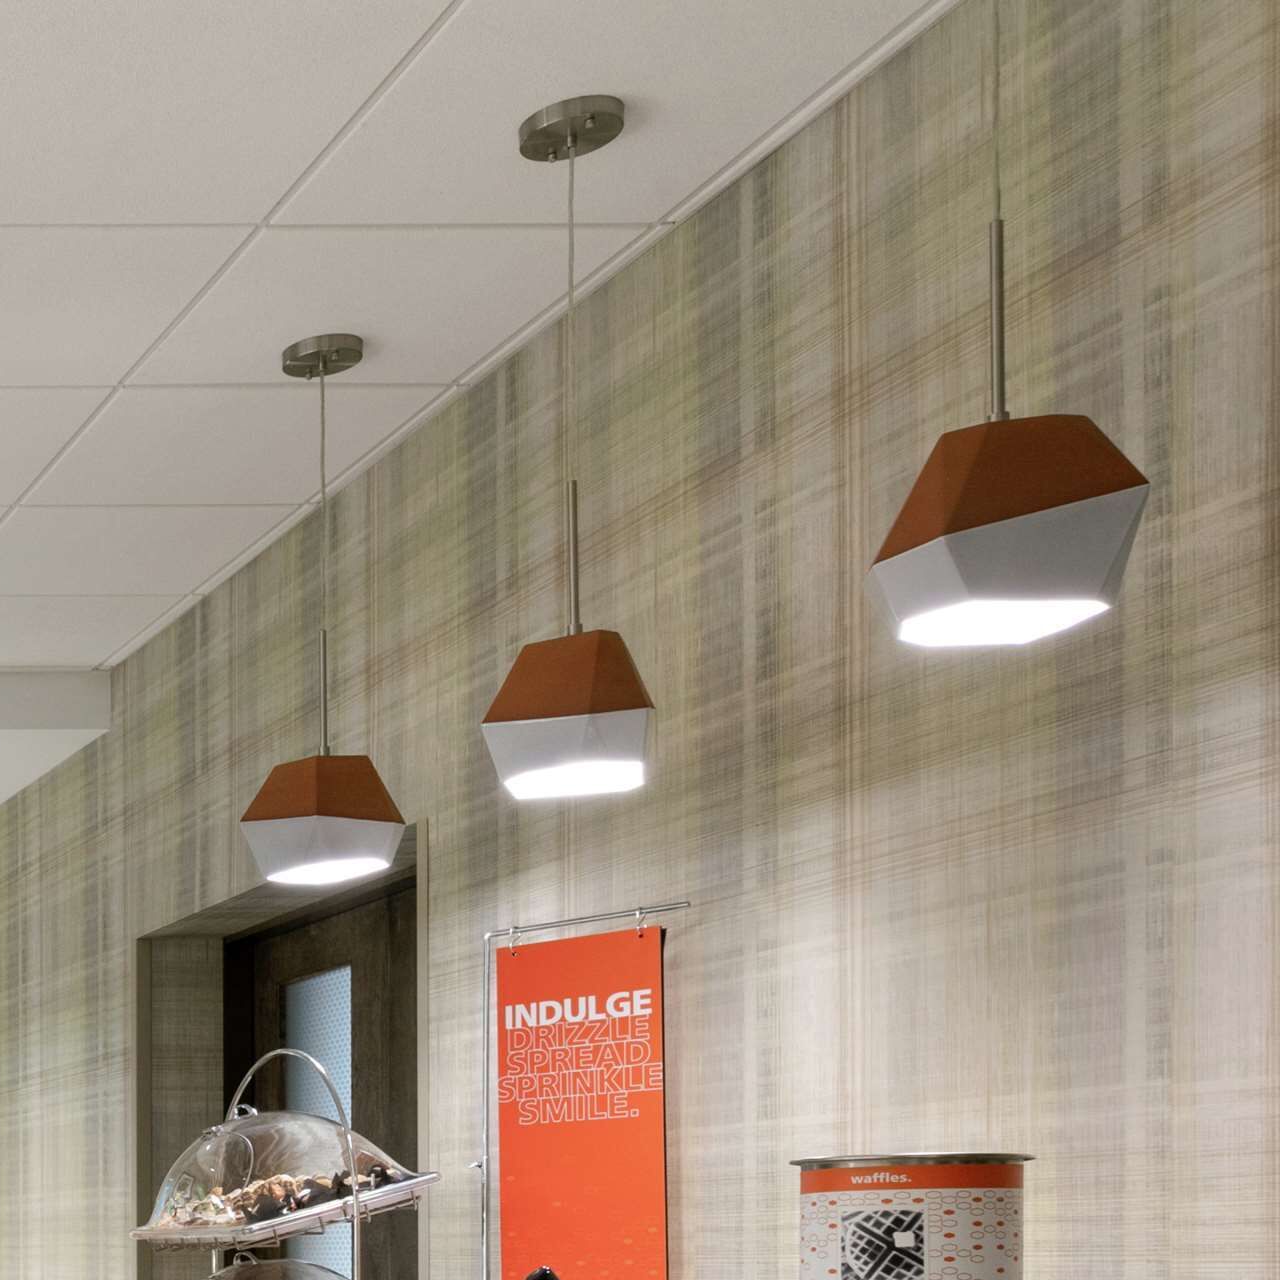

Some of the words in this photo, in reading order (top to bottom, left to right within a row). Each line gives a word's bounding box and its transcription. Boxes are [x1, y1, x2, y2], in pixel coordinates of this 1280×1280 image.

[505, 988, 653, 1029] INDULGE
[507, 1015, 651, 1052] DRIZZLE
[506, 1039, 652, 1077] SPREAD
[497, 1062, 663, 1103] SPRINKLE
[518, 1090, 640, 1126] SMILE.
[850, 1172, 912, 1184] waffles.
